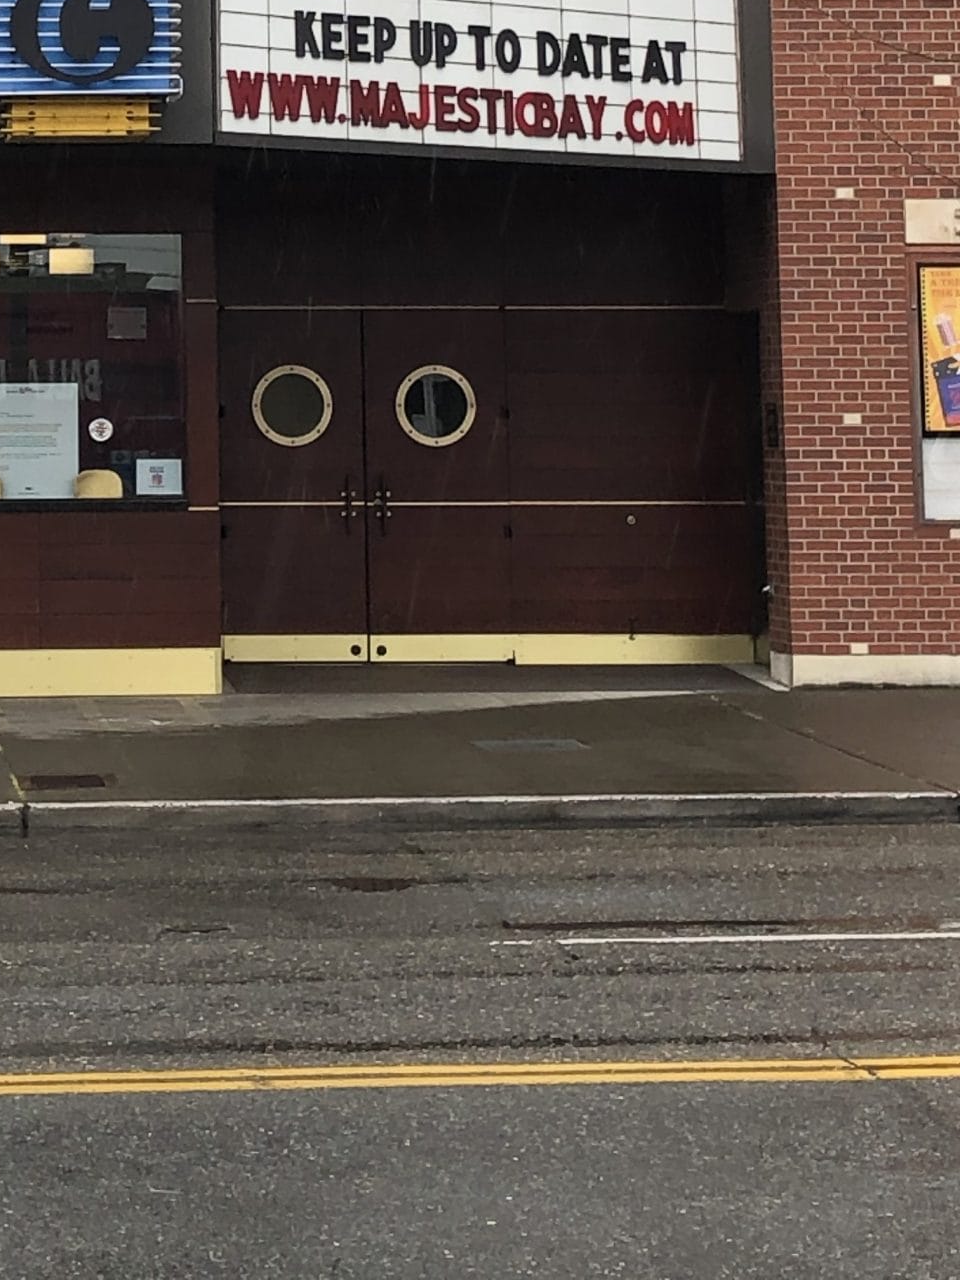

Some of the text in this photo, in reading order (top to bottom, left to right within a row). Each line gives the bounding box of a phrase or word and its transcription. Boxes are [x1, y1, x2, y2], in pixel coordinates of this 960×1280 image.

[294, 10, 687, 86] KEEP UP TO DATE AT
